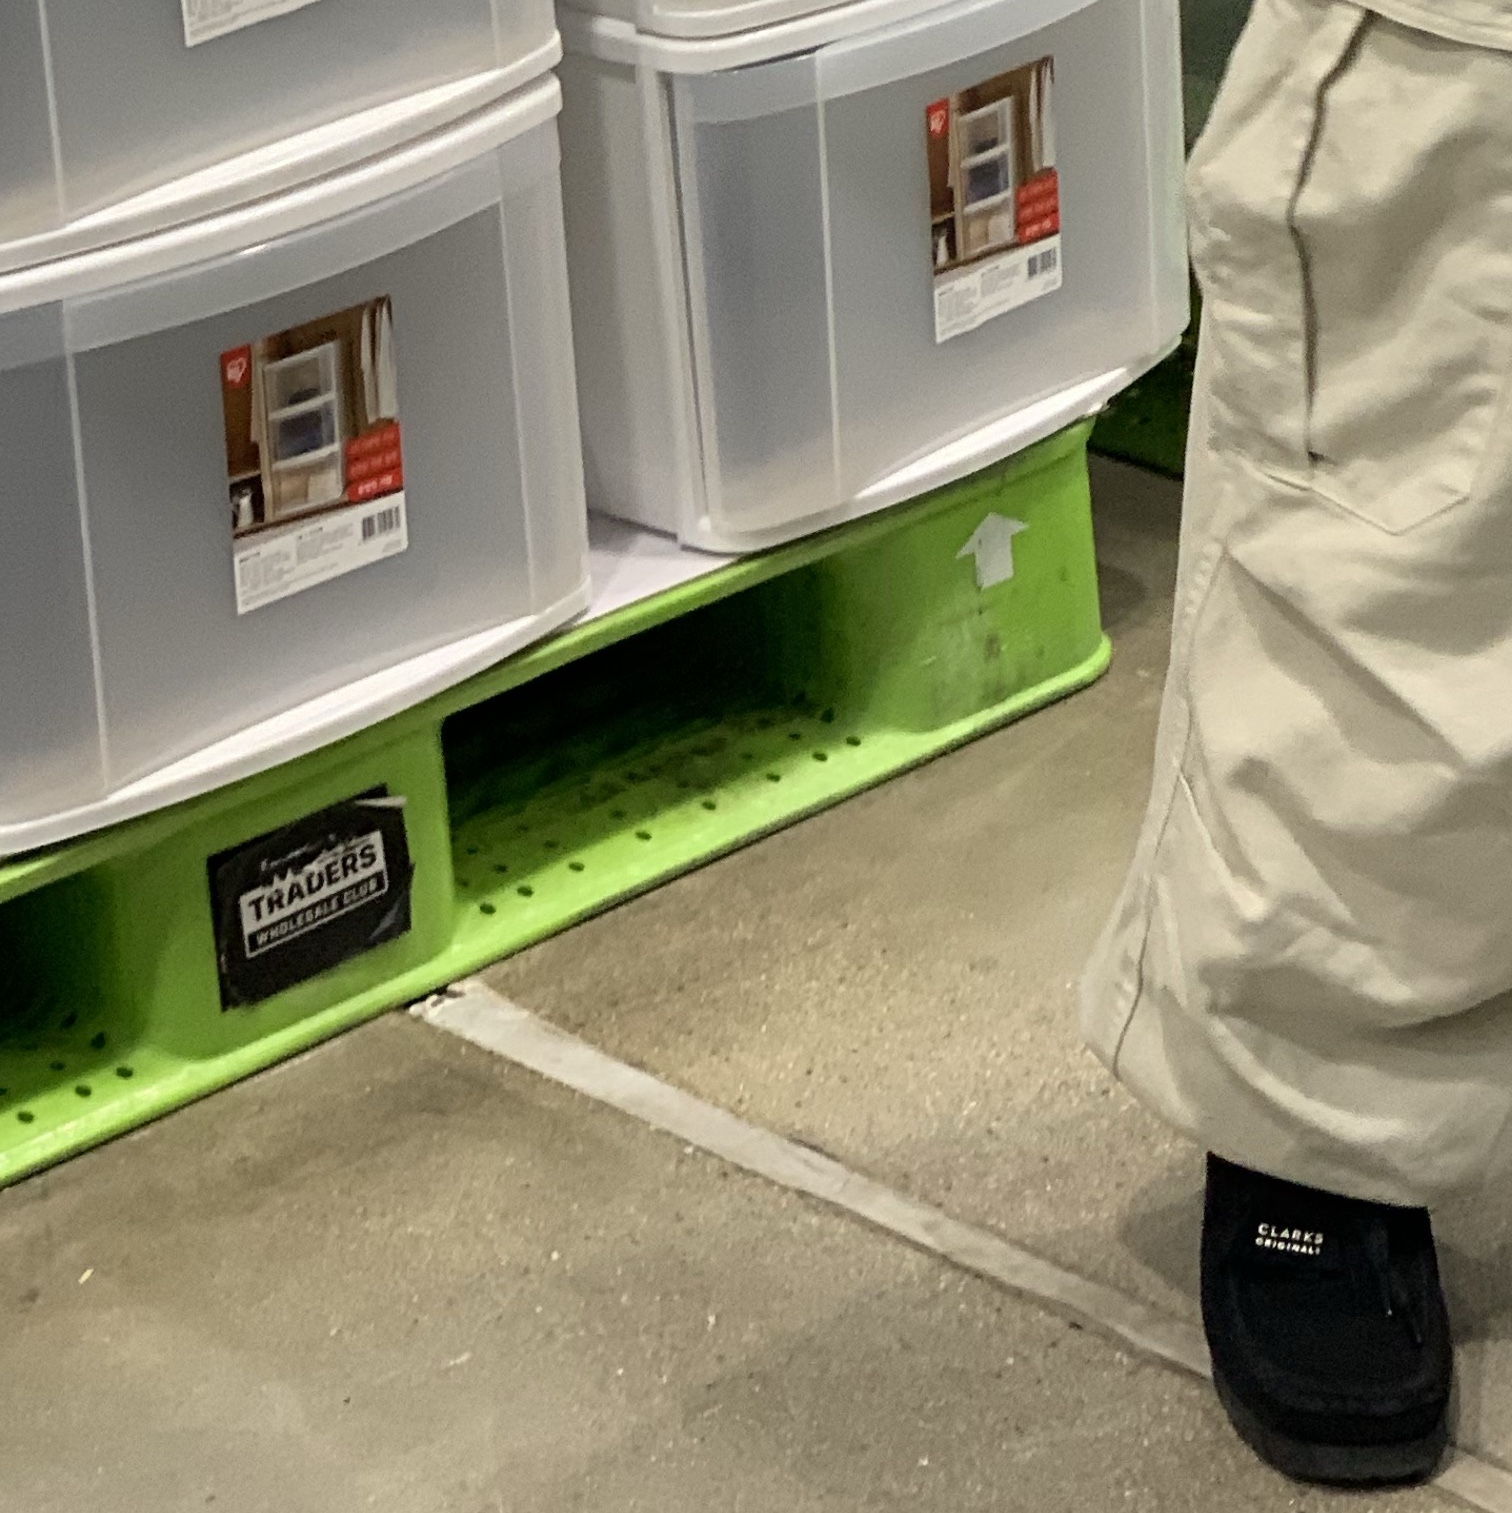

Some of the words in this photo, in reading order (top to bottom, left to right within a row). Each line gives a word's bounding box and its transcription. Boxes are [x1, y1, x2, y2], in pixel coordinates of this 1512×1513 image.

[248, 844, 378, 922] TRADERS
[256, 897, 340, 944] WHOLESALE
[342, 878, 379, 905] CLUB
[1258, 1222, 1324, 1244] CLARKS
